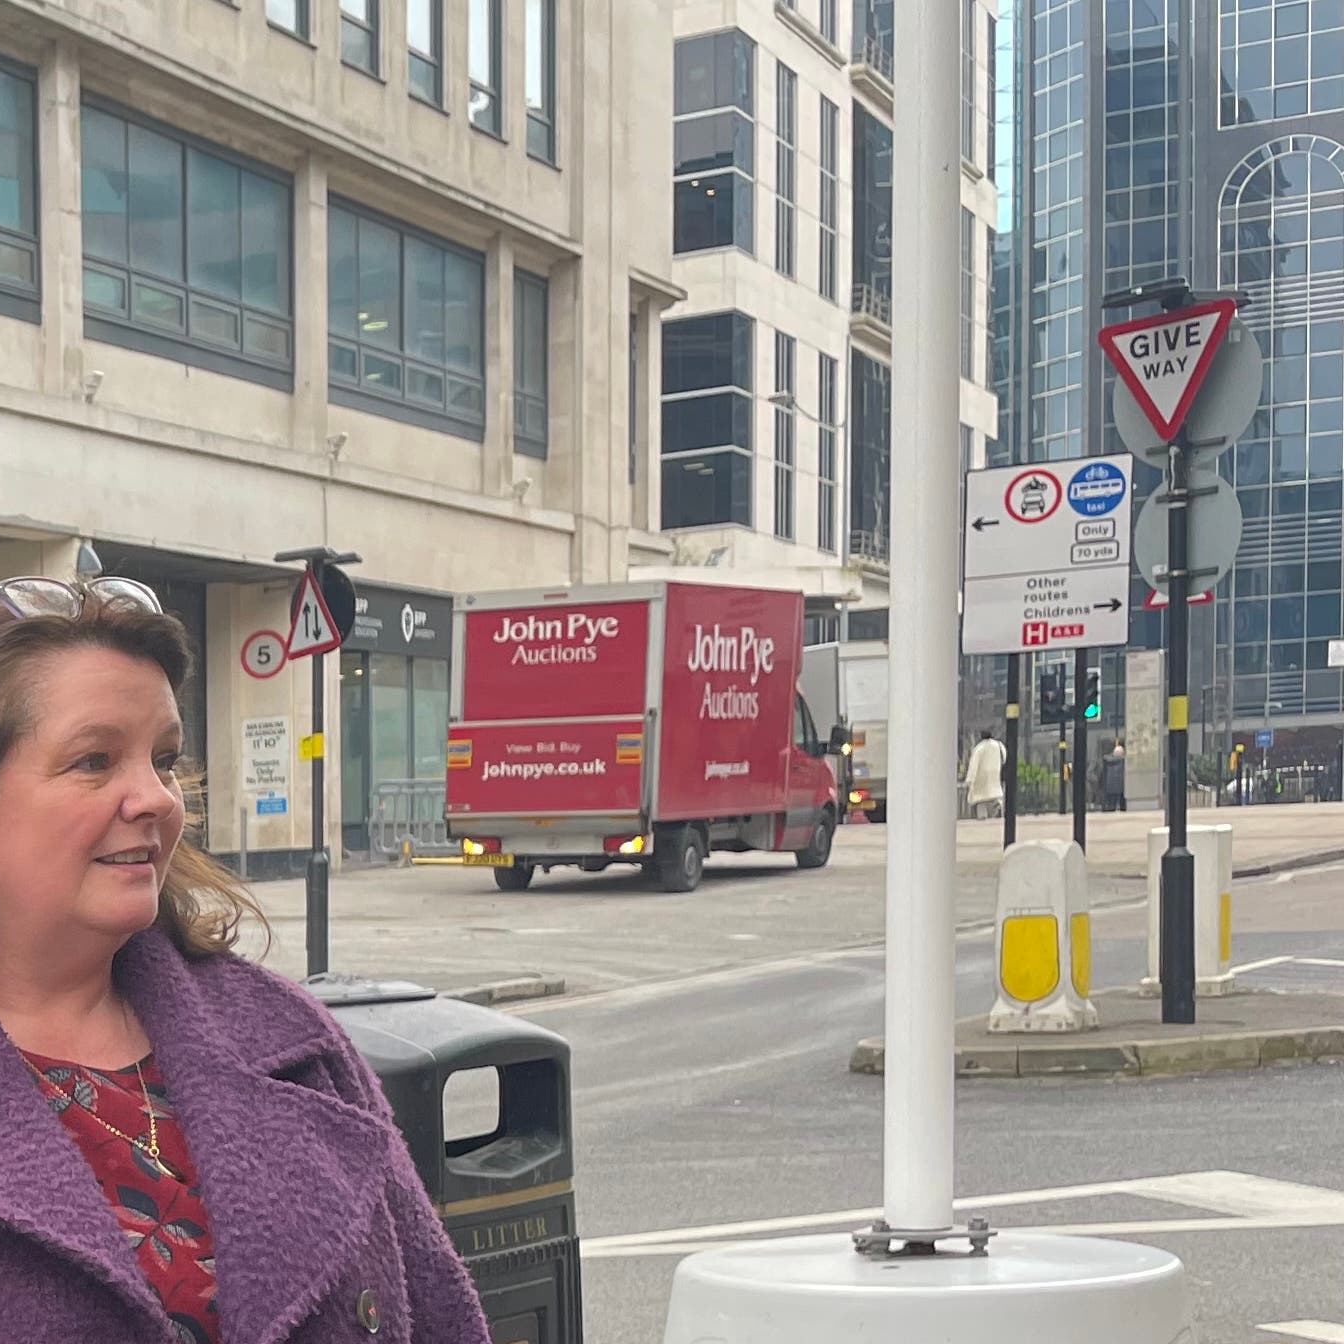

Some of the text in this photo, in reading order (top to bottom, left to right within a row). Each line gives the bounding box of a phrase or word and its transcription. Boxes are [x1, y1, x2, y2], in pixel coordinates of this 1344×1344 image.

[1129, 321, 1201, 358] GIVE
[1143, 356, 1188, 380] WAY
[1081, 525, 1109, 538] Only
[1077, 546, 1113, 558] 70 yds
[1026, 578, 1067, 590] Other
[1024, 591, 1069, 603] routes
[1024, 604, 1091, 620] Childrens
[493, 613, 619, 645] John Pye
[1052, 625, 1081, 638] A&E
[256, 644, 271, 665] 5
[511, 645, 597, 665] Auctions
[688, 623, 775, 687] John Pye
[699, 682, 760, 721] Auctions
[506, 743, 532, 754] View
[560, 741, 581, 754] Buy
[482, 758, 607, 781] johnpye.co.uk
[258, 776, 285, 784] Parking
[473, 1217, 548, 1251] LITTER
